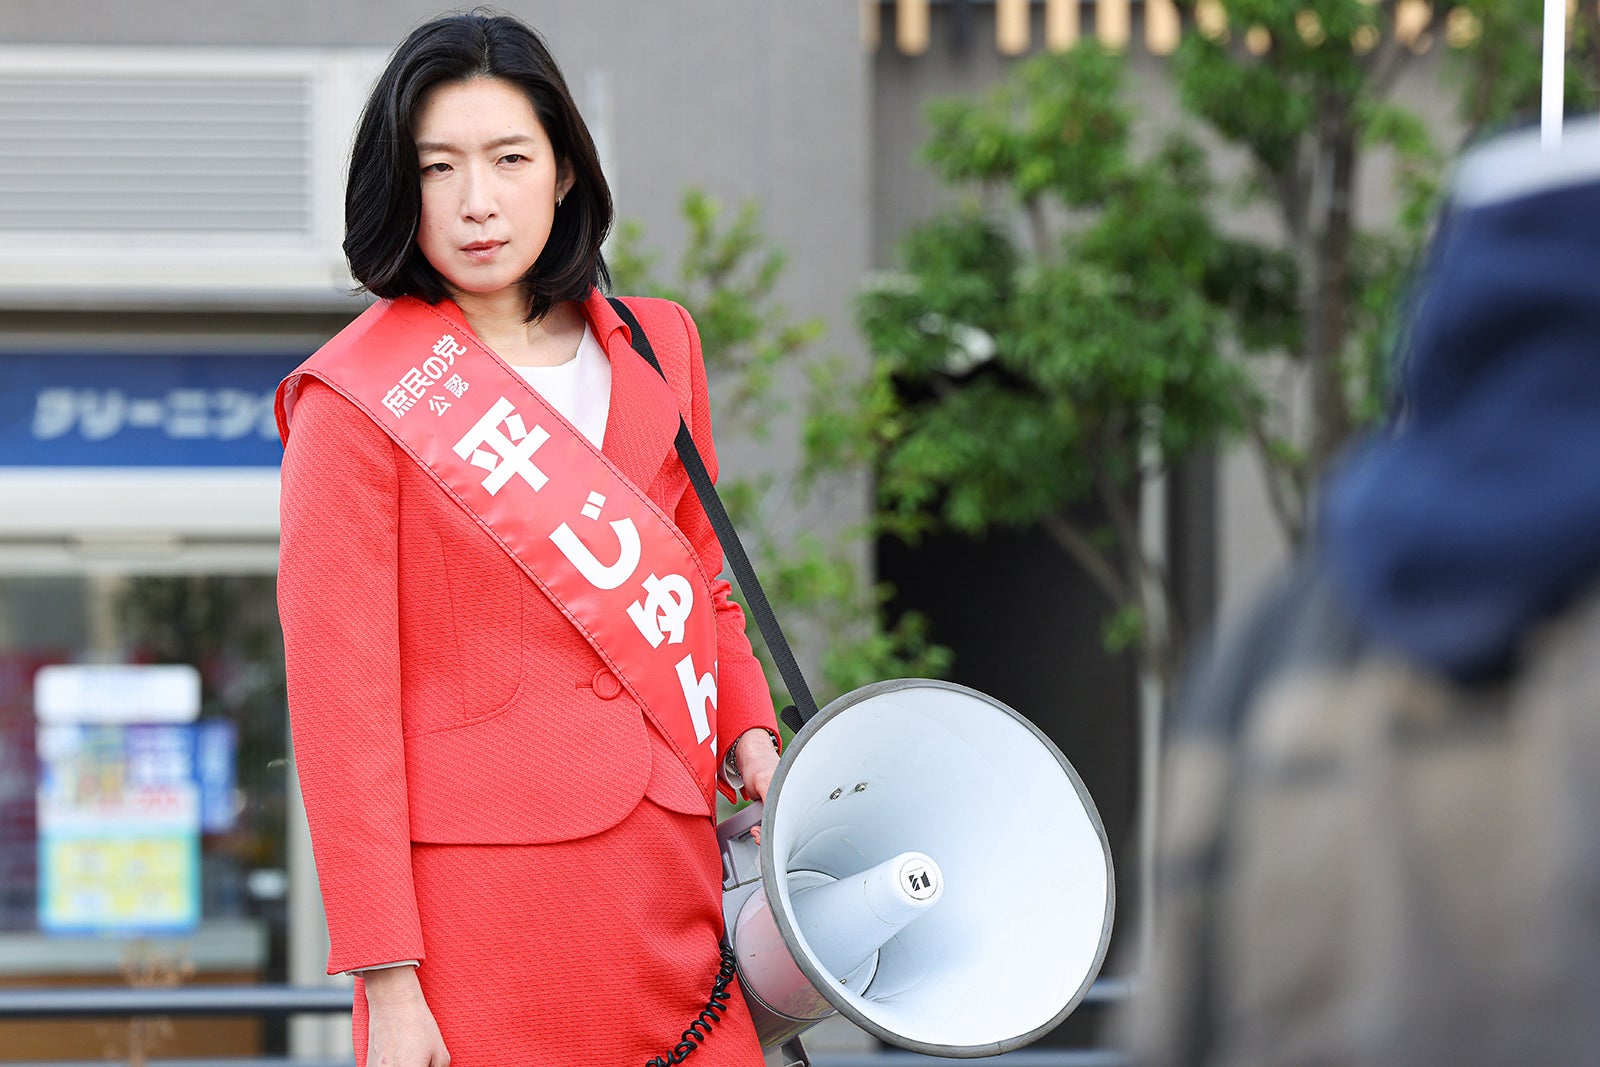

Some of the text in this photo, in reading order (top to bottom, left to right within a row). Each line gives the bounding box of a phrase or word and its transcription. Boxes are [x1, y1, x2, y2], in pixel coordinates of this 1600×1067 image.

[381, 334, 468, 419] 庶民の党
[428, 373, 470, 417] 公認
